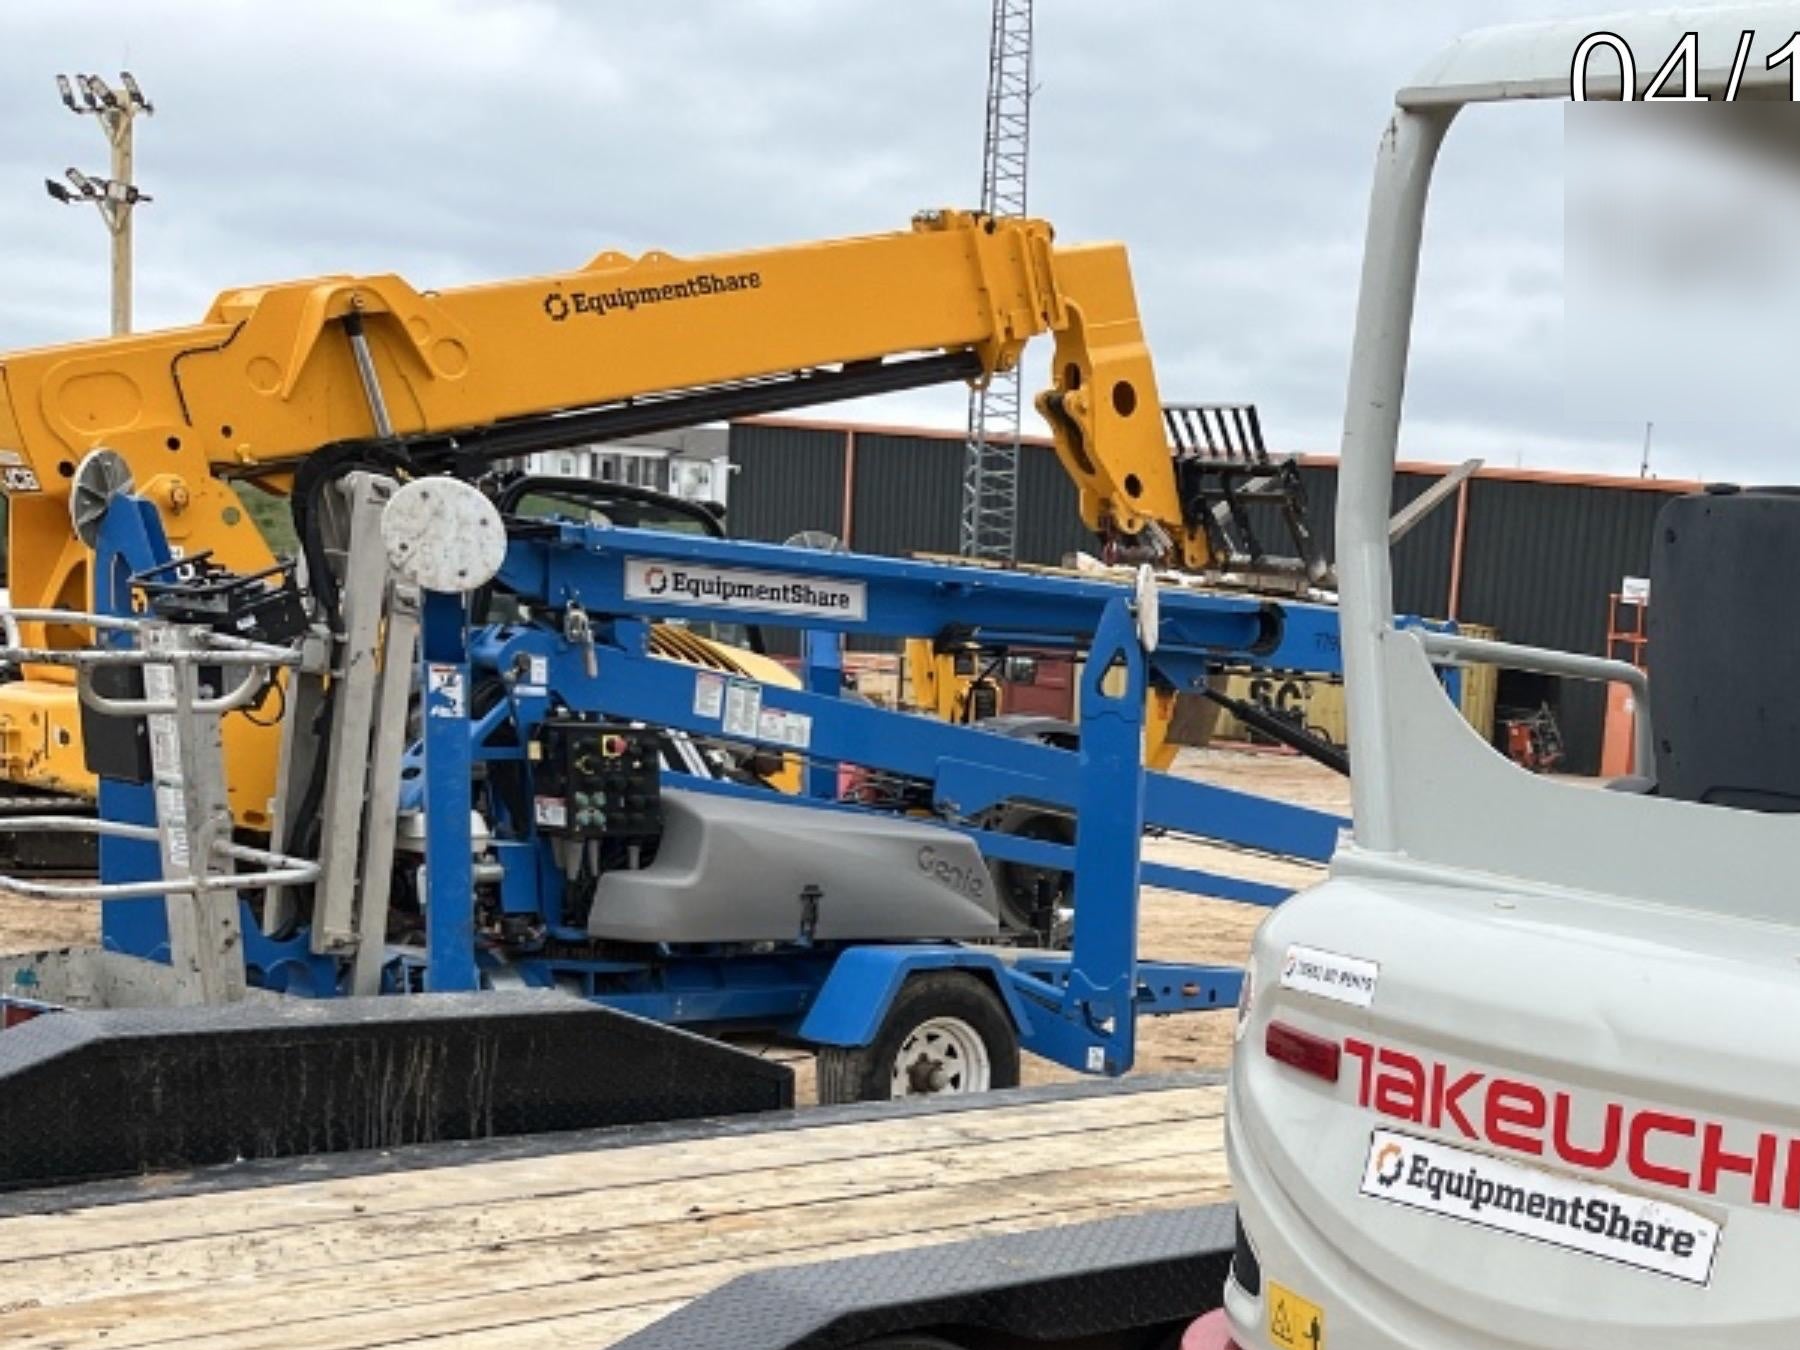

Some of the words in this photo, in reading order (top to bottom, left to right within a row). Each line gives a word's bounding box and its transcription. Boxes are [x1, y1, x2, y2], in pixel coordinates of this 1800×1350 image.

[571, 272, 761, 315] EquipmentShare
[671, 572, 849, 609] EquipmentShare
[918, 845, 984, 898] Genie
[1404, 1153, 1697, 1260] EquipmentShare
